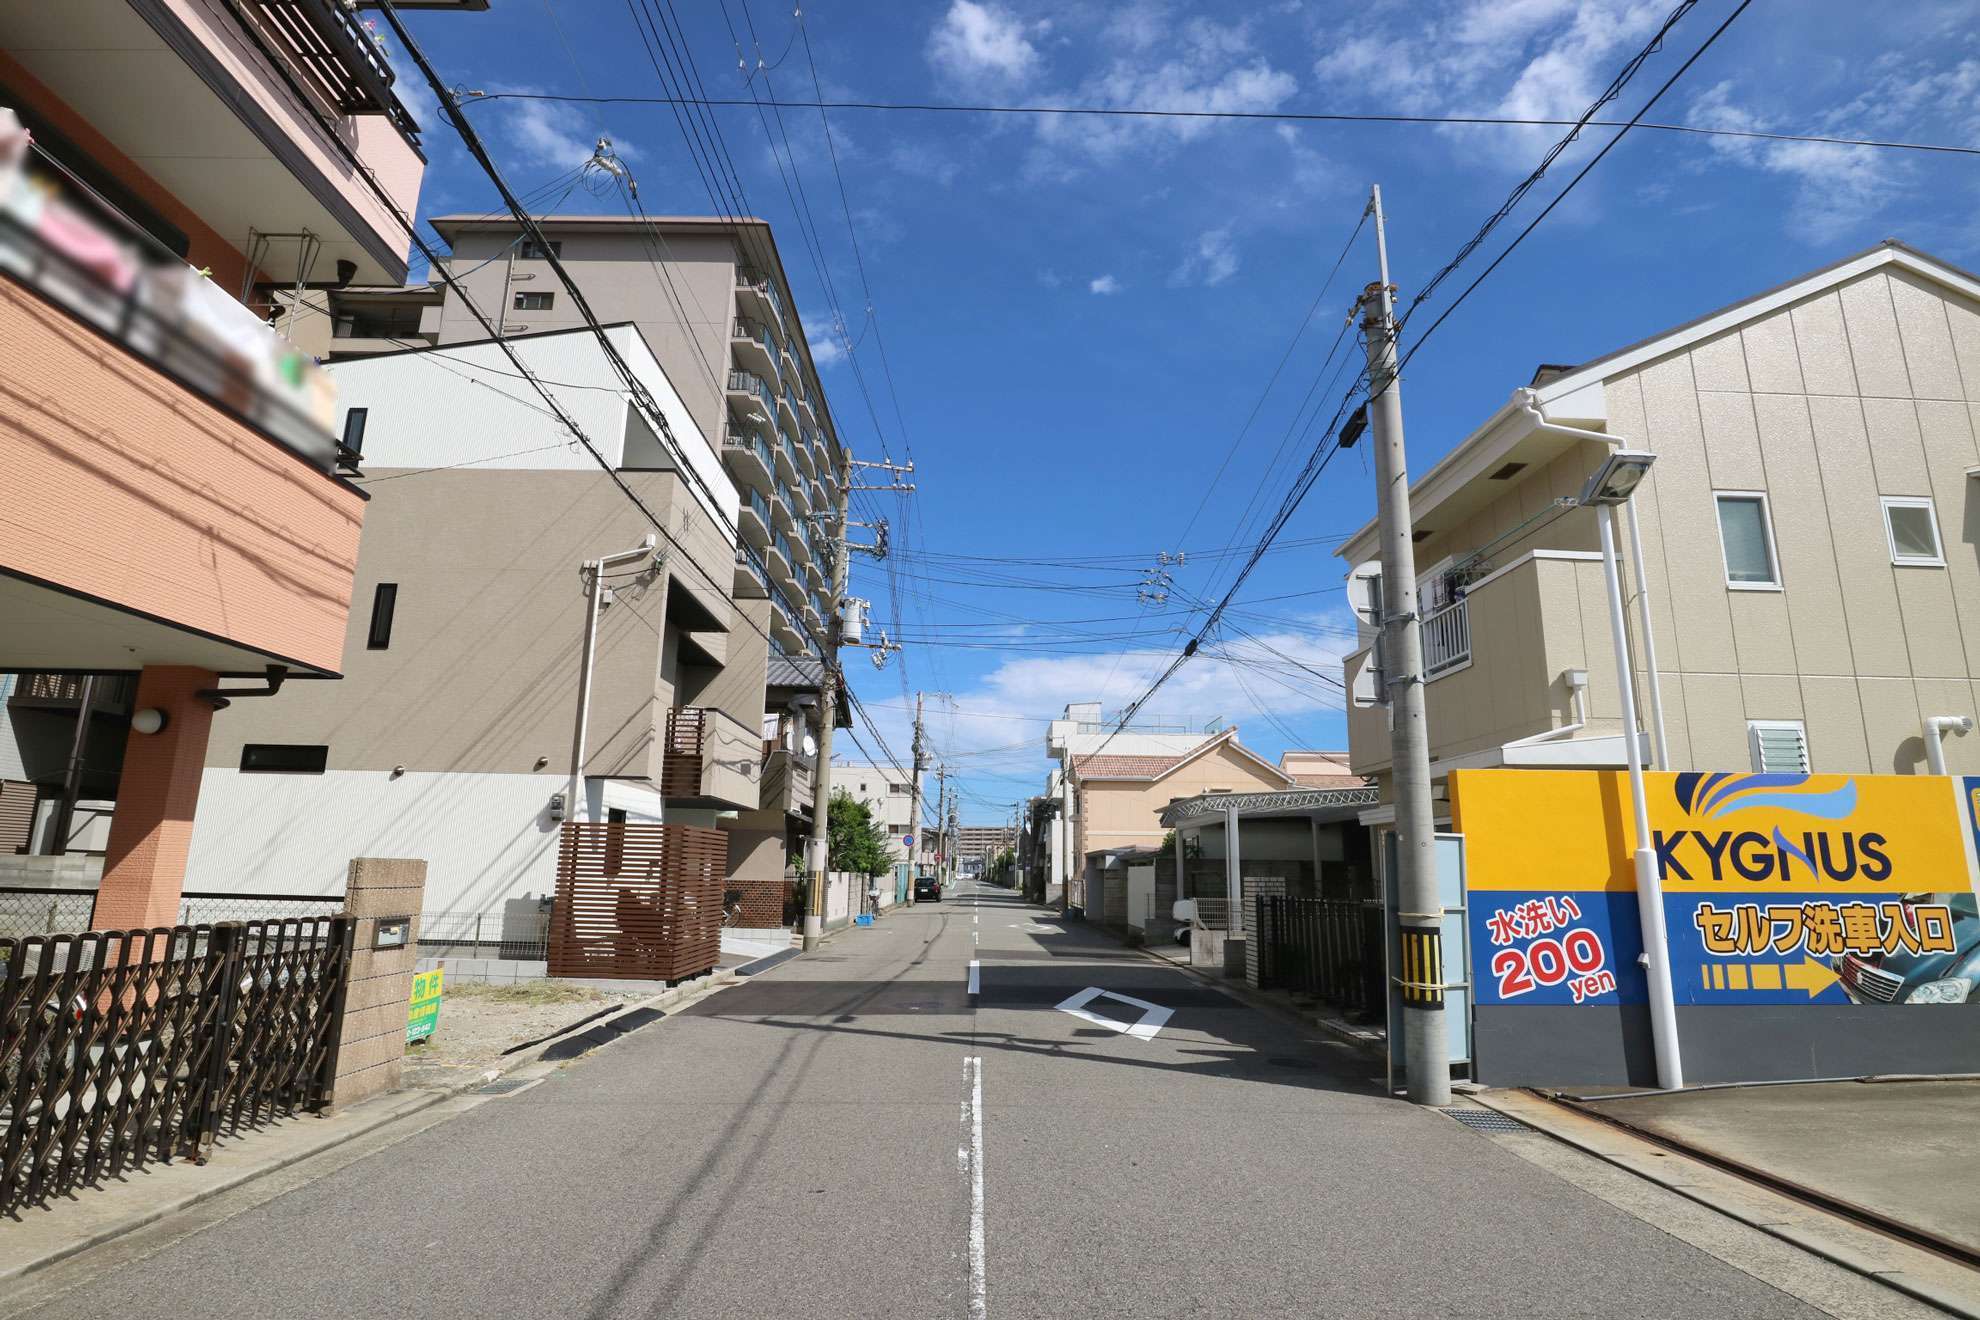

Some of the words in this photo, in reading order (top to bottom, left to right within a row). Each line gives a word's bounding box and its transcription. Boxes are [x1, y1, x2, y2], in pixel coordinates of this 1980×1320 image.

[1652, 826, 1892, 882] KYGNUS
[1487, 897, 1581, 945] 水洗い
[1694, 902, 1956, 955] セルフ洗車入口
[1492, 928, 1604, 999] 200
[1568, 970, 1617, 1003] yen
